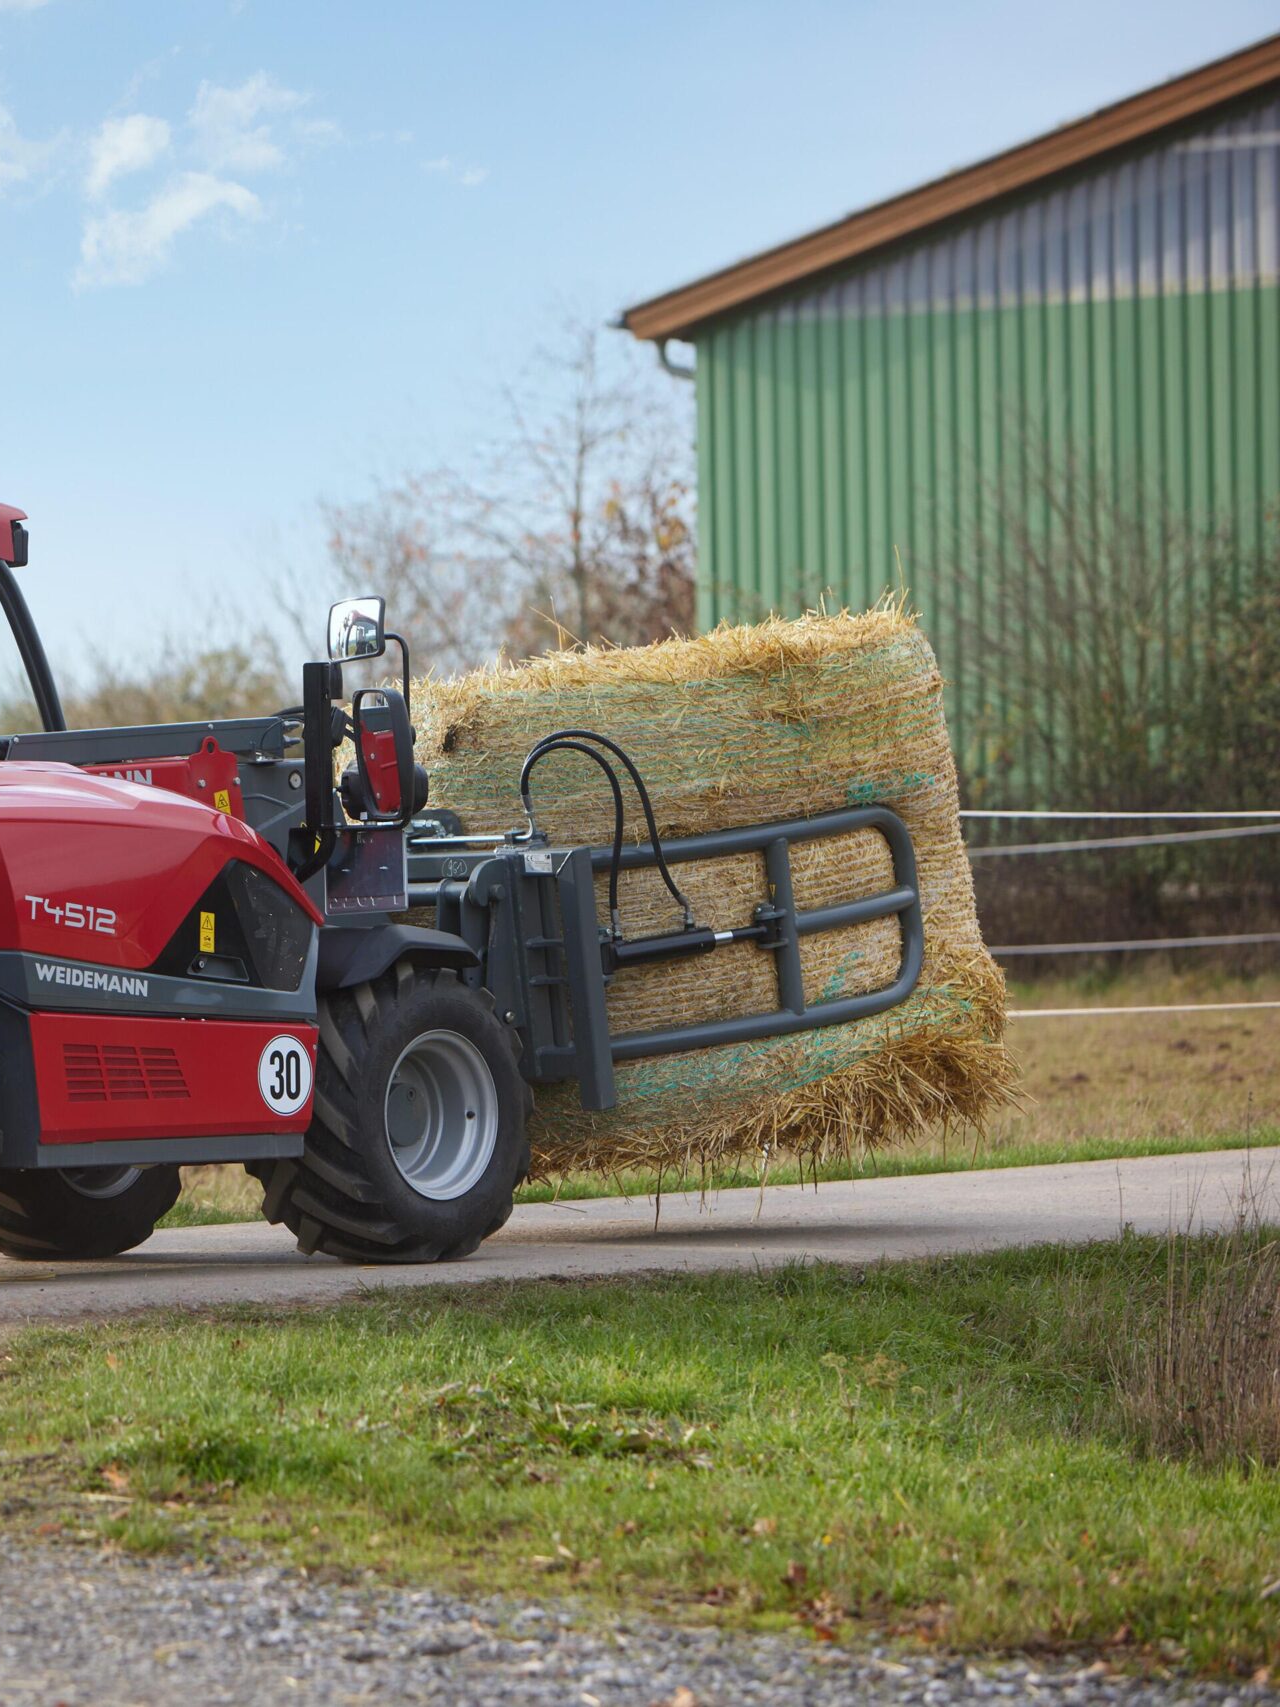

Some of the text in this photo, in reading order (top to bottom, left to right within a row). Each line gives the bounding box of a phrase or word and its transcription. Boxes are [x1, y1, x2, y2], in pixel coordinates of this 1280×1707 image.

[24, 895, 117, 934] T4512
[35, 962, 148, 997] WEIDEMANN
[270, 1050, 301, 1100] 30
